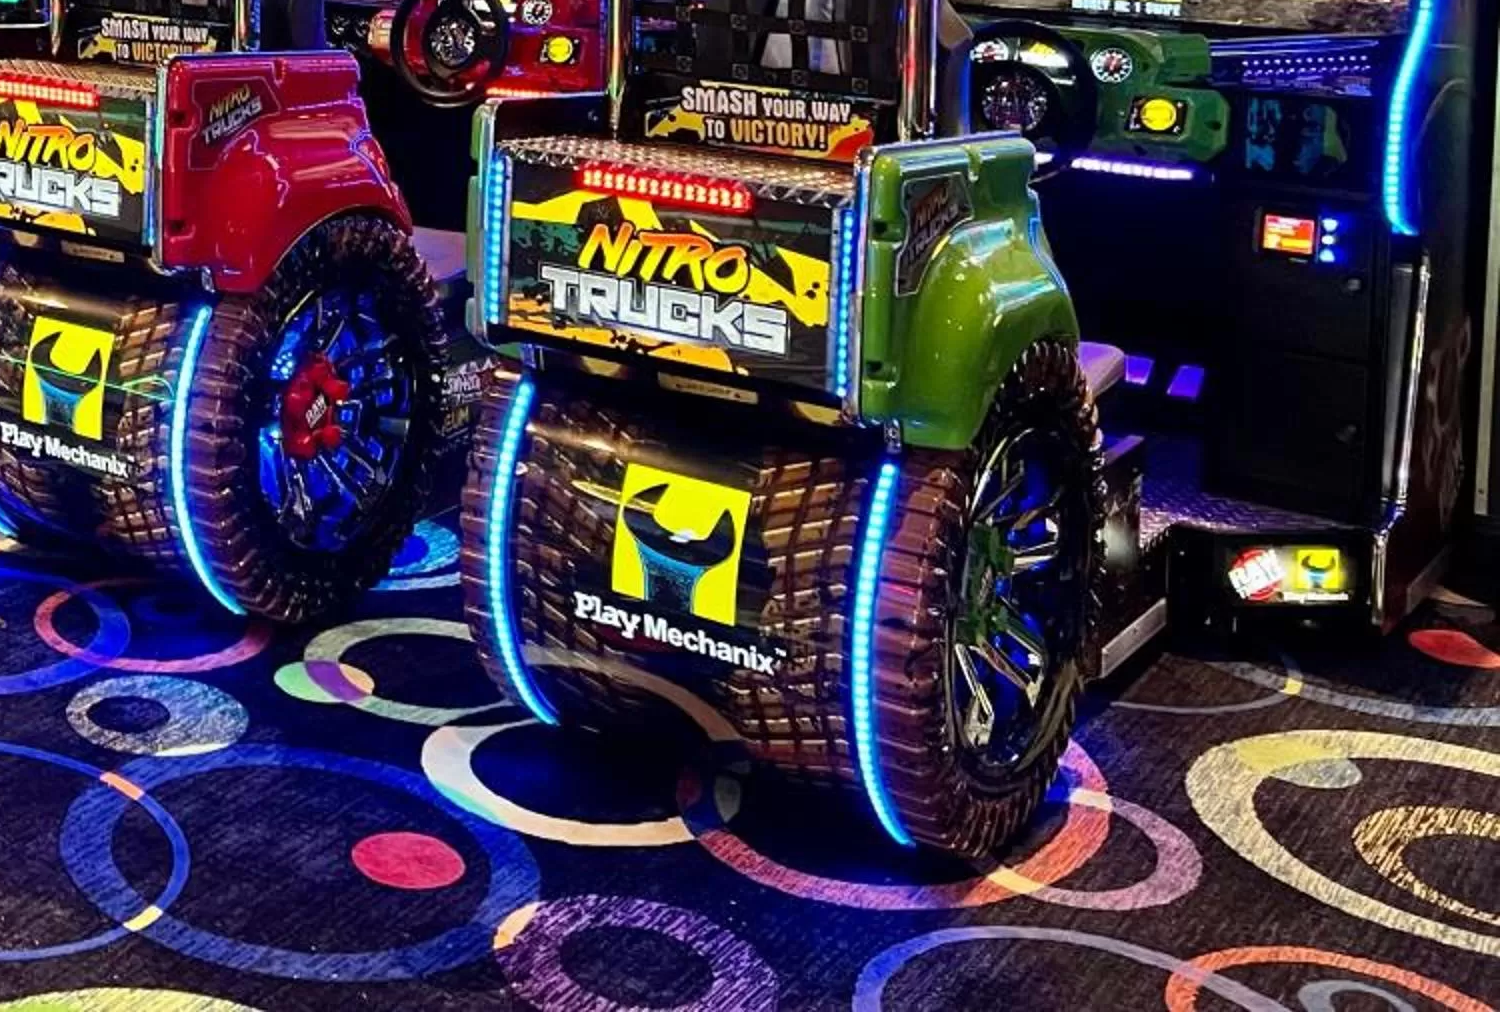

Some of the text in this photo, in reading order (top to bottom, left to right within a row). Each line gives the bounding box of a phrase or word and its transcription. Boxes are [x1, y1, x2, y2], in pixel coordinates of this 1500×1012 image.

[101, 16, 150, 39] SMASH
[152, 24, 181, 42] YOUR
[116, 43, 129, 60] TO
[682, 86, 851, 123] SMASH YOUR WAY
[705, 118, 827, 150] TO VICTORY!
[540, 264, 788, 356] TRUCKS
[0, 421, 129, 479] Play Mechanix
[573, 590, 776, 677] Play Mechanix
